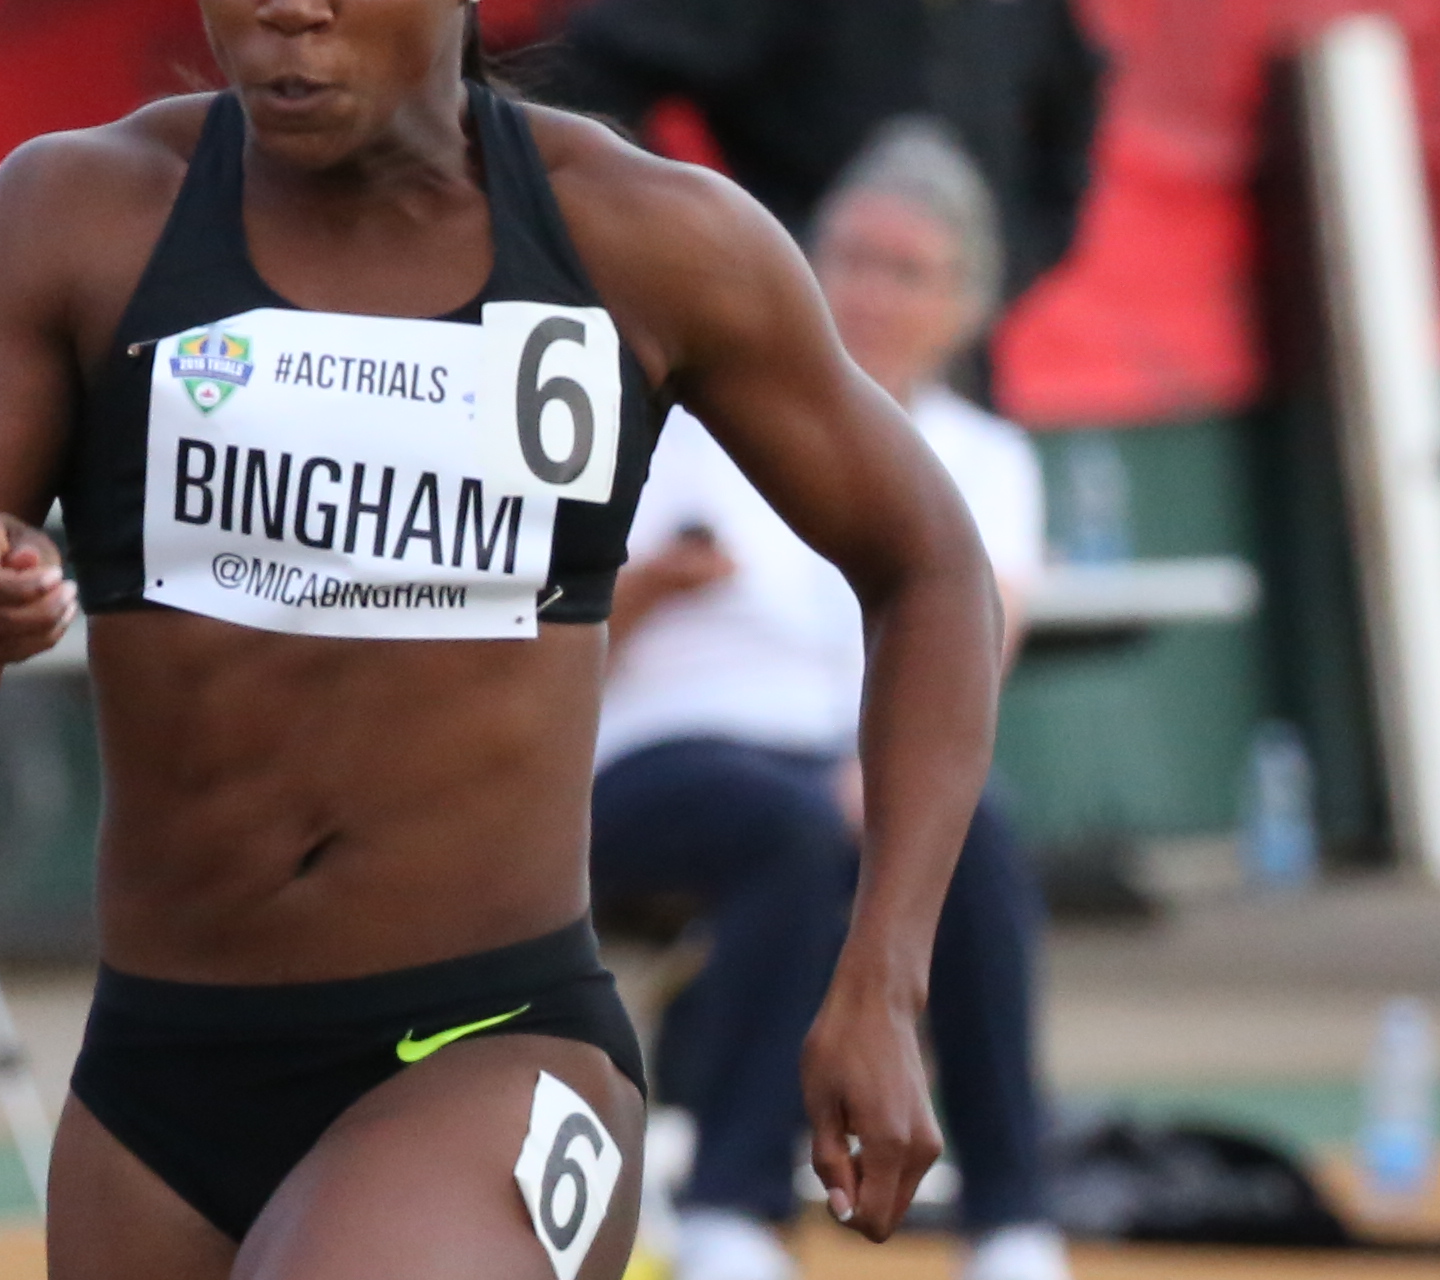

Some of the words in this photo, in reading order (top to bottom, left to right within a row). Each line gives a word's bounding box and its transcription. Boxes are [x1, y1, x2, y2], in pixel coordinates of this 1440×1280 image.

[275, 352, 448, 404] #ACTRIALS
[516, 316, 594, 485] 6
[174, 438, 523, 575] BINGHAM
[212, 552, 468, 609] @MICABINGHAM
[540, 1112, 604, 1251] 6
